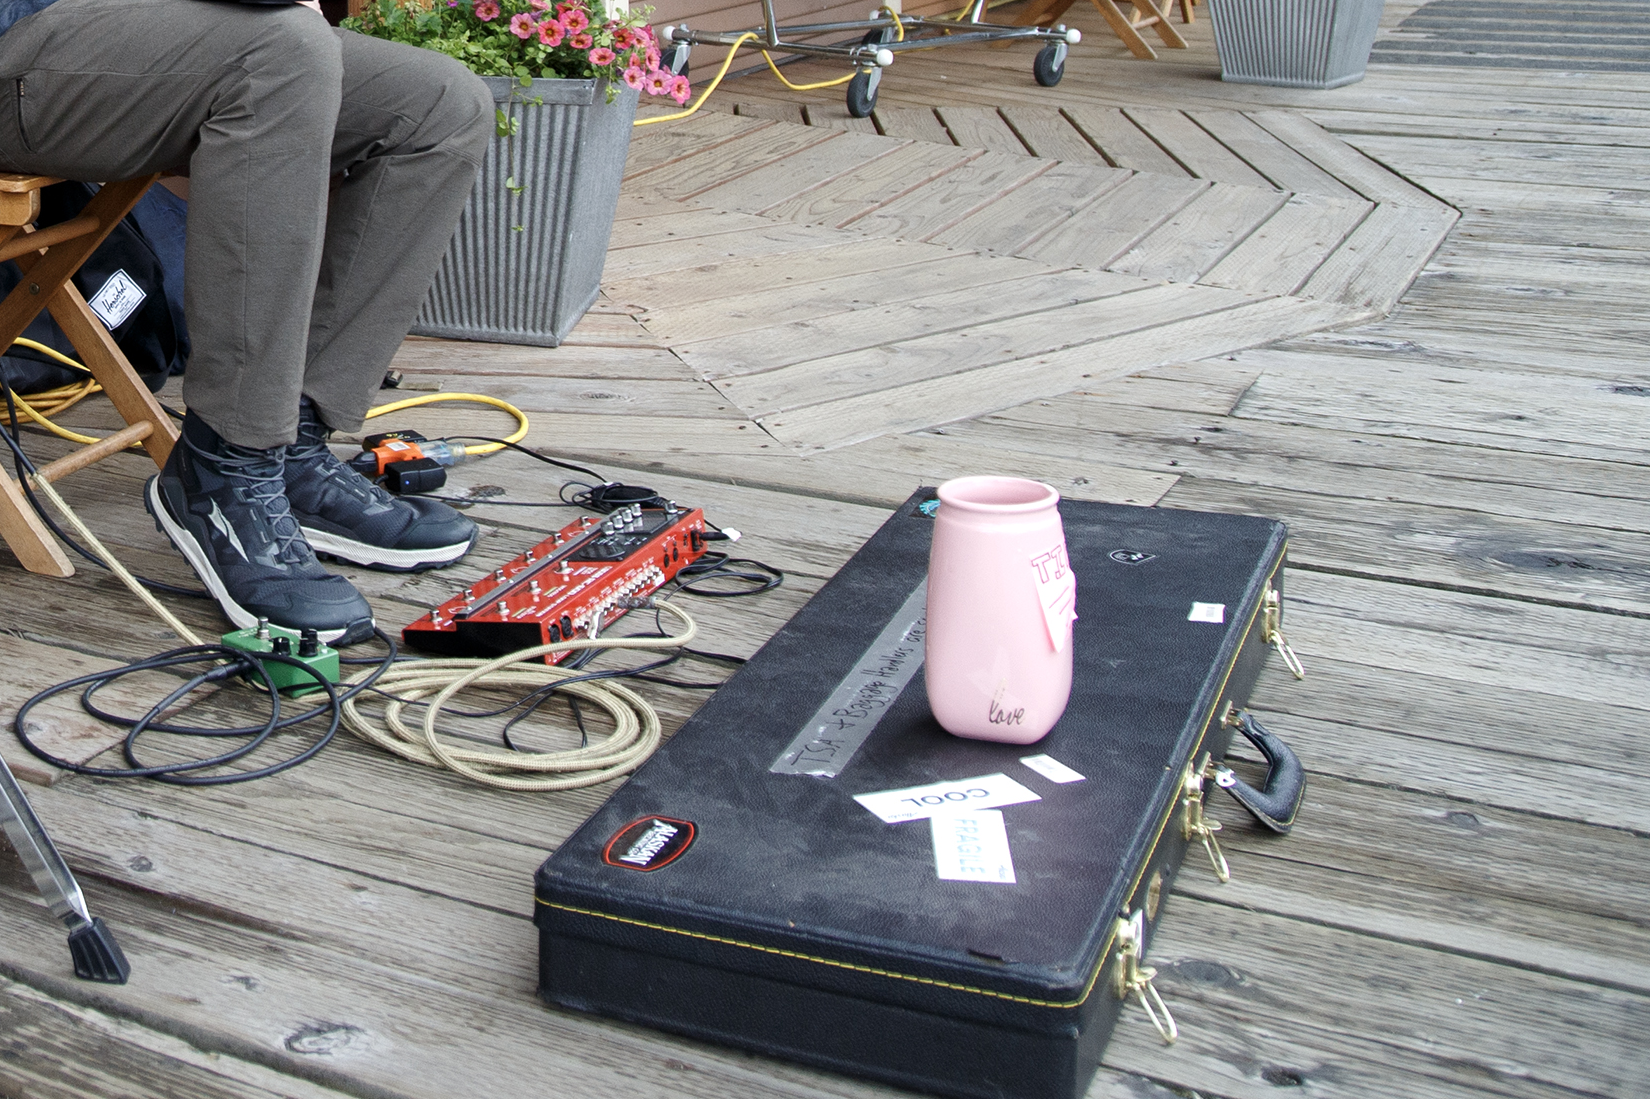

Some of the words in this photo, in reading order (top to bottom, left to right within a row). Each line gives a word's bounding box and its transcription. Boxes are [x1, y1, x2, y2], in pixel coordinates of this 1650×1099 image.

[102, 279, 127, 314] Herschel
[791, 739, 845, 766] TSA
[901, 788, 990, 807] COOL
[618, 818, 679, 866] ALASKAN
[954, 818, 986, 875] FRAGILE
